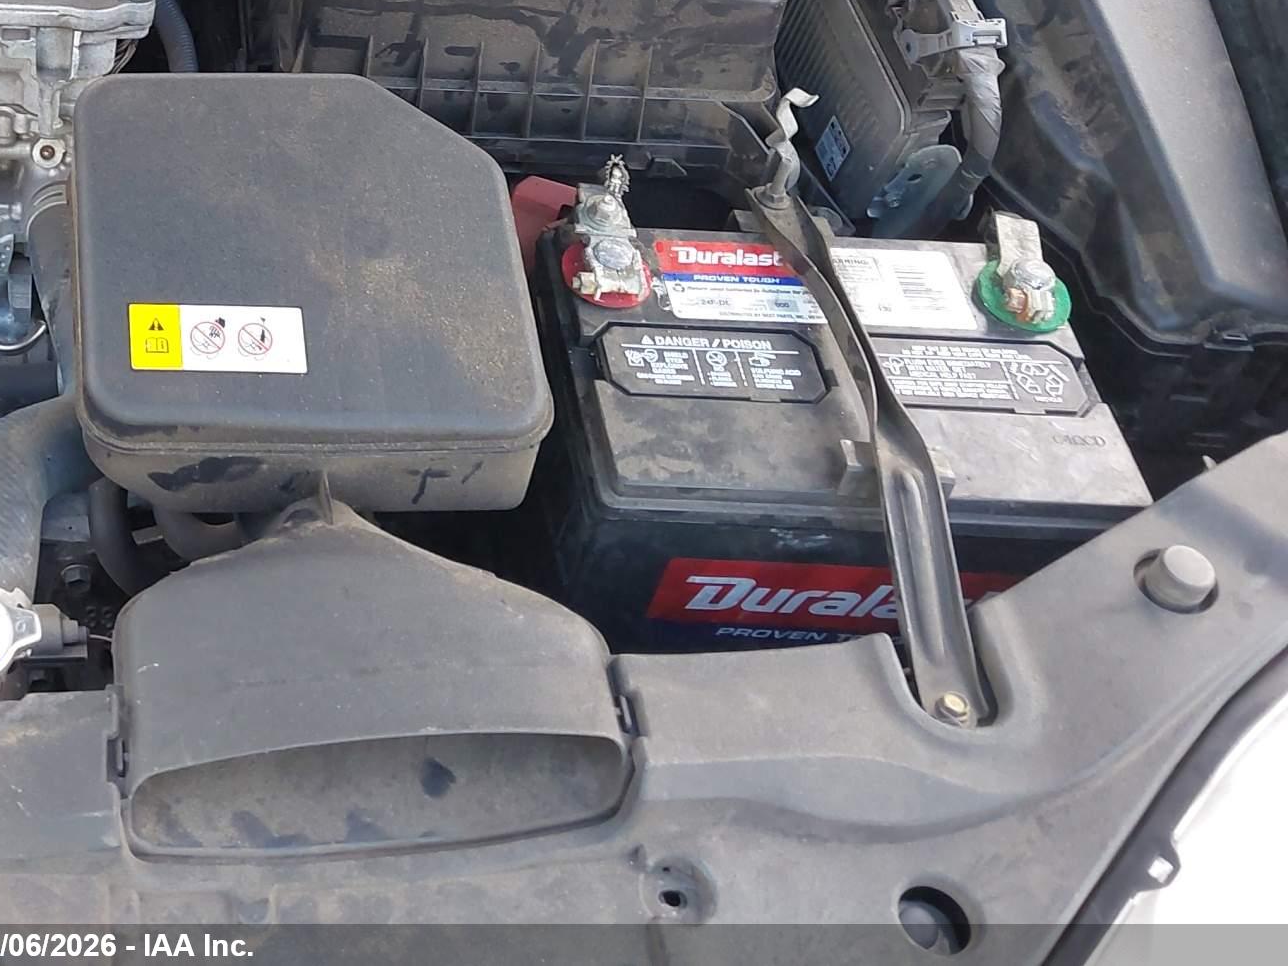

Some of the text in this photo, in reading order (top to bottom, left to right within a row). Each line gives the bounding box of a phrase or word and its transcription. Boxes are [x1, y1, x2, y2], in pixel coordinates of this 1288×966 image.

[670, 246, 784, 267] Duralast
[693, 274, 781, 285] PROVEN TOUGH
[654, 335, 710, 348] DANGER
[723, 338, 773, 351] POISON
[714, 626, 827, 642] PROVEN
